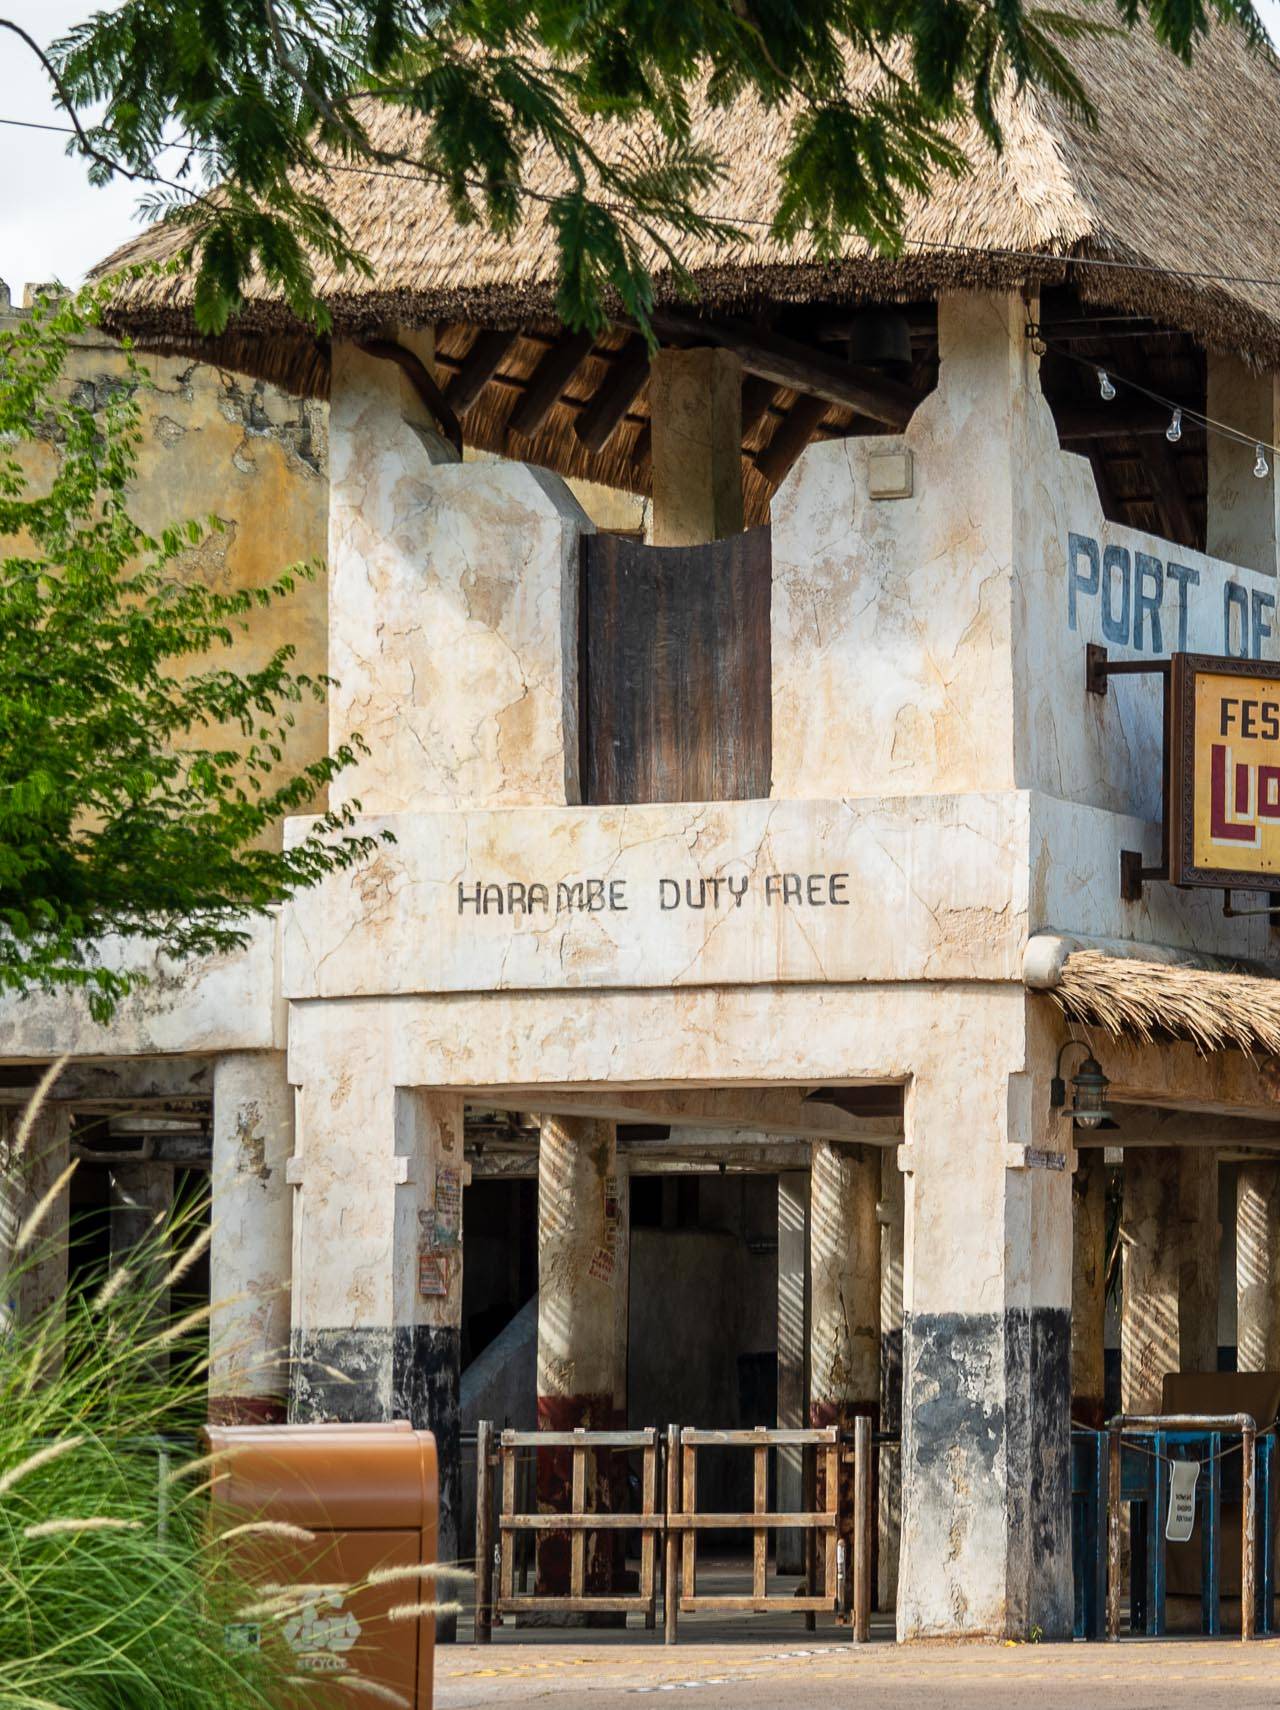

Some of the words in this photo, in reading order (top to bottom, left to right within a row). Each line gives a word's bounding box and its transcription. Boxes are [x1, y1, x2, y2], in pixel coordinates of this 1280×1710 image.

[1068, 532, 1200, 654] PORT
[1224, 580, 1276, 659] OF
[457, 879, 628, 915] HARAMBE
[659, 875, 748, 911] DUTY
[765, 873, 850, 907] FREE
